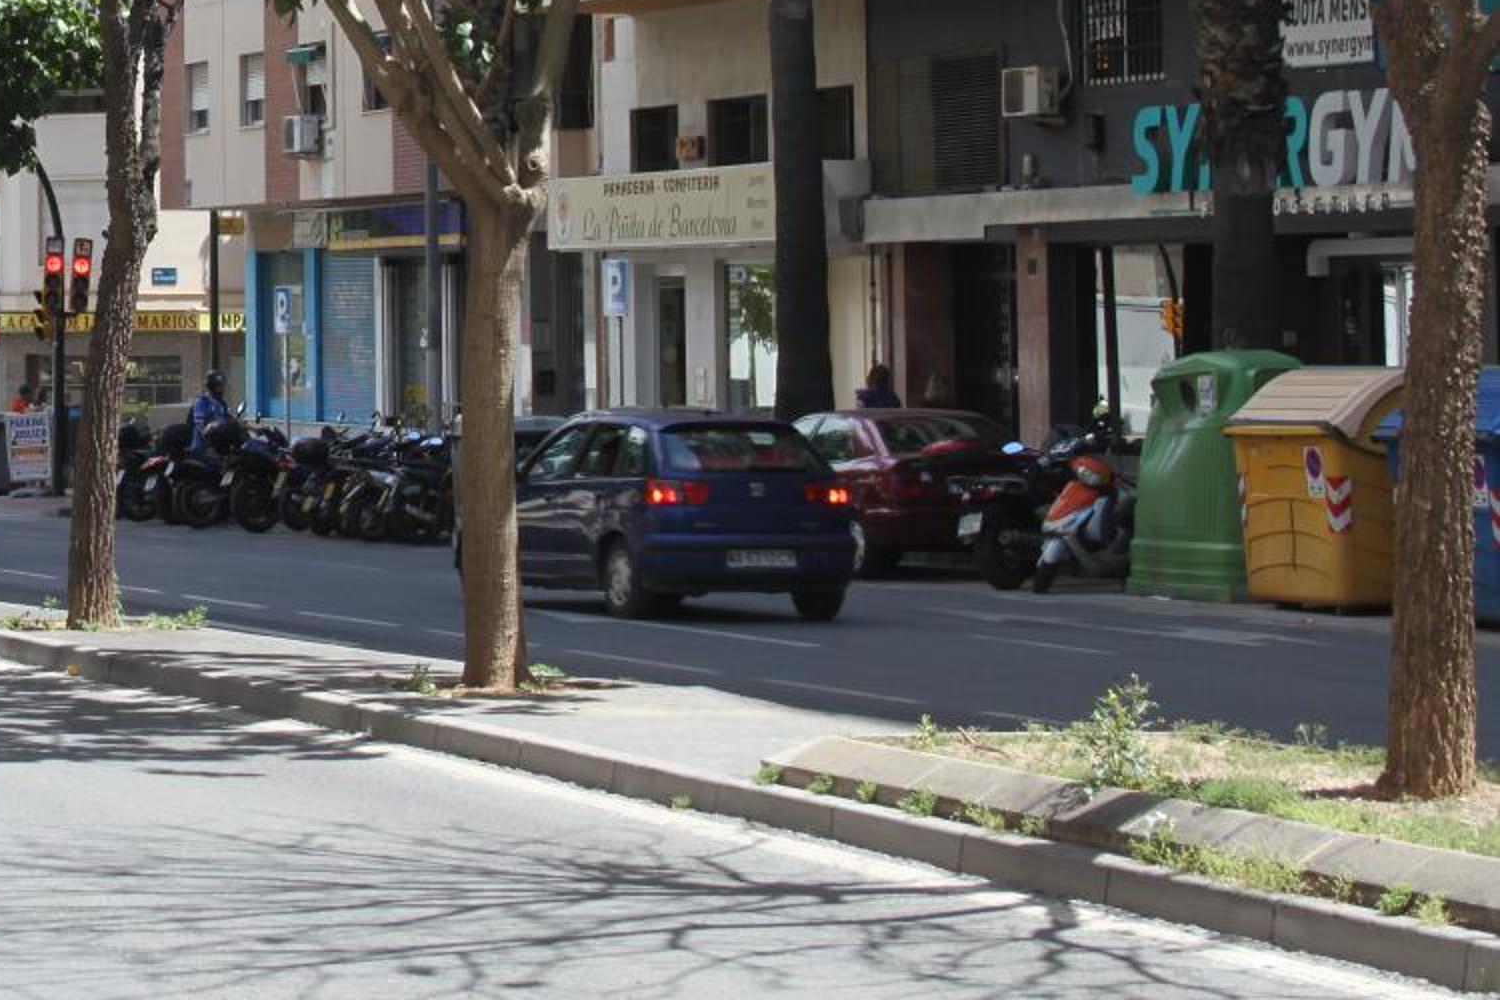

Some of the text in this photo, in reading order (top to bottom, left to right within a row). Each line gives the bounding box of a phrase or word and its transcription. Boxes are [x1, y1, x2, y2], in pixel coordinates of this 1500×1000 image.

[1286, 35, 1373, 60] www.synergy
[1132, 87, 1416, 198] SYRGY
[667, 202, 737, 237] Barcelona
